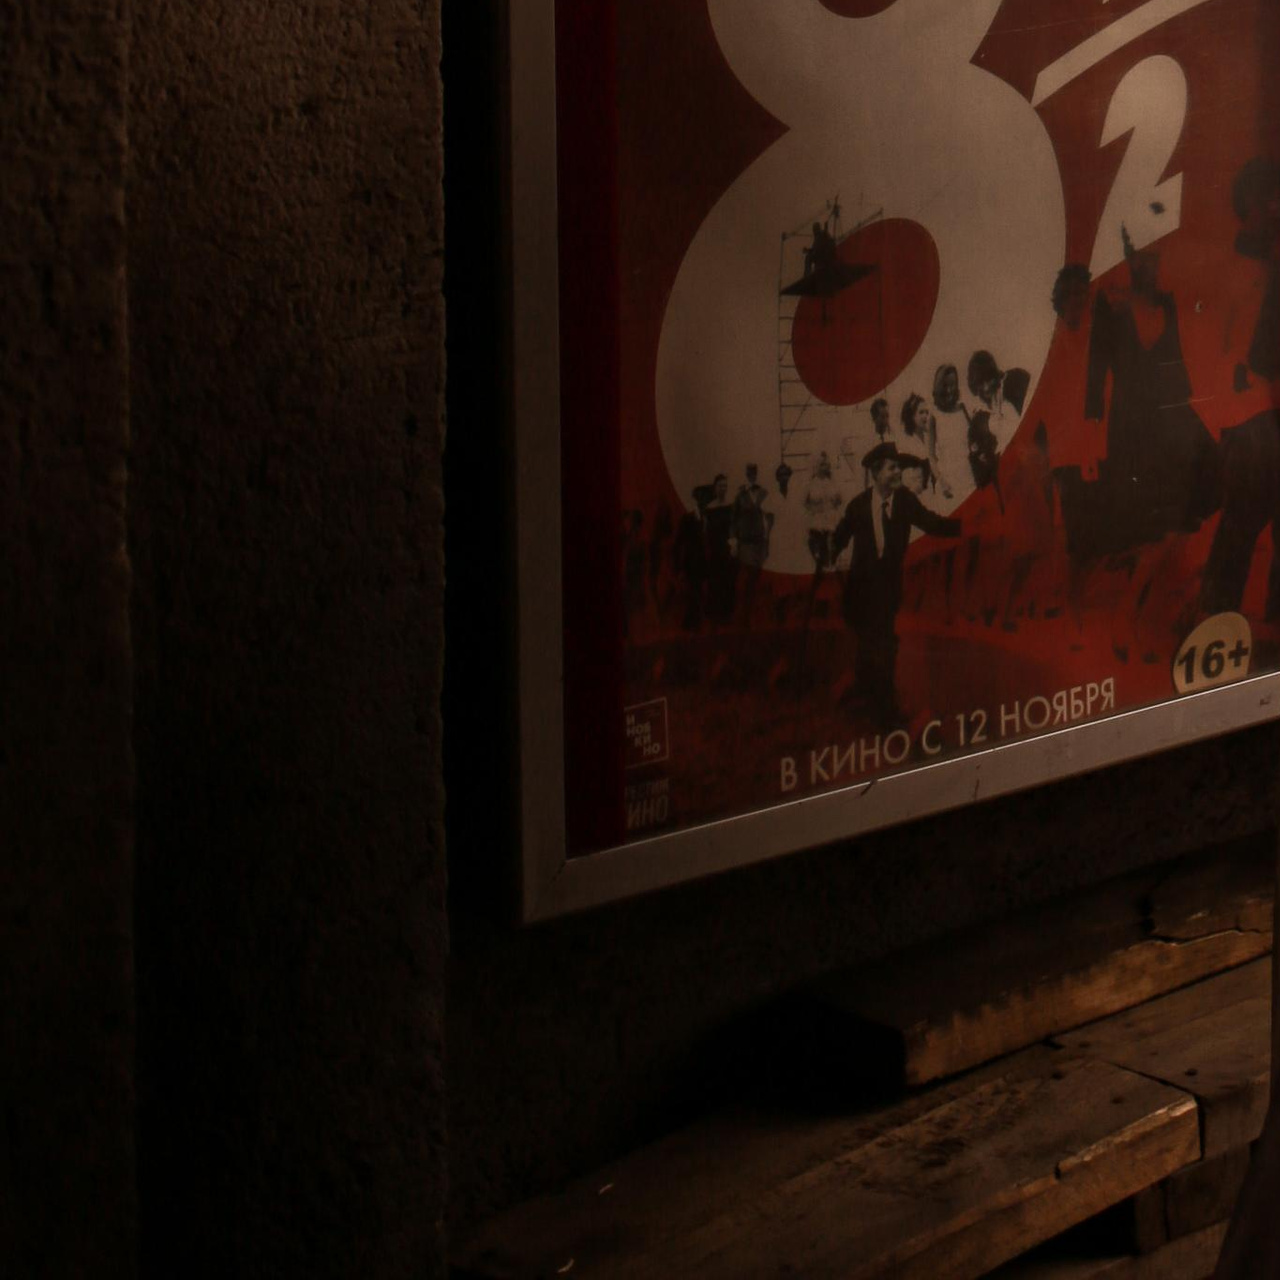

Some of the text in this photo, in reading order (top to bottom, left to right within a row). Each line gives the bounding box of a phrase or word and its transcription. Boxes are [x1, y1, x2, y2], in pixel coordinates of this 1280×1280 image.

[1176, 639, 1250, 685] 16+
[780, 676, 1117, 791] В КИНО С 12 НОЯБРЯ
